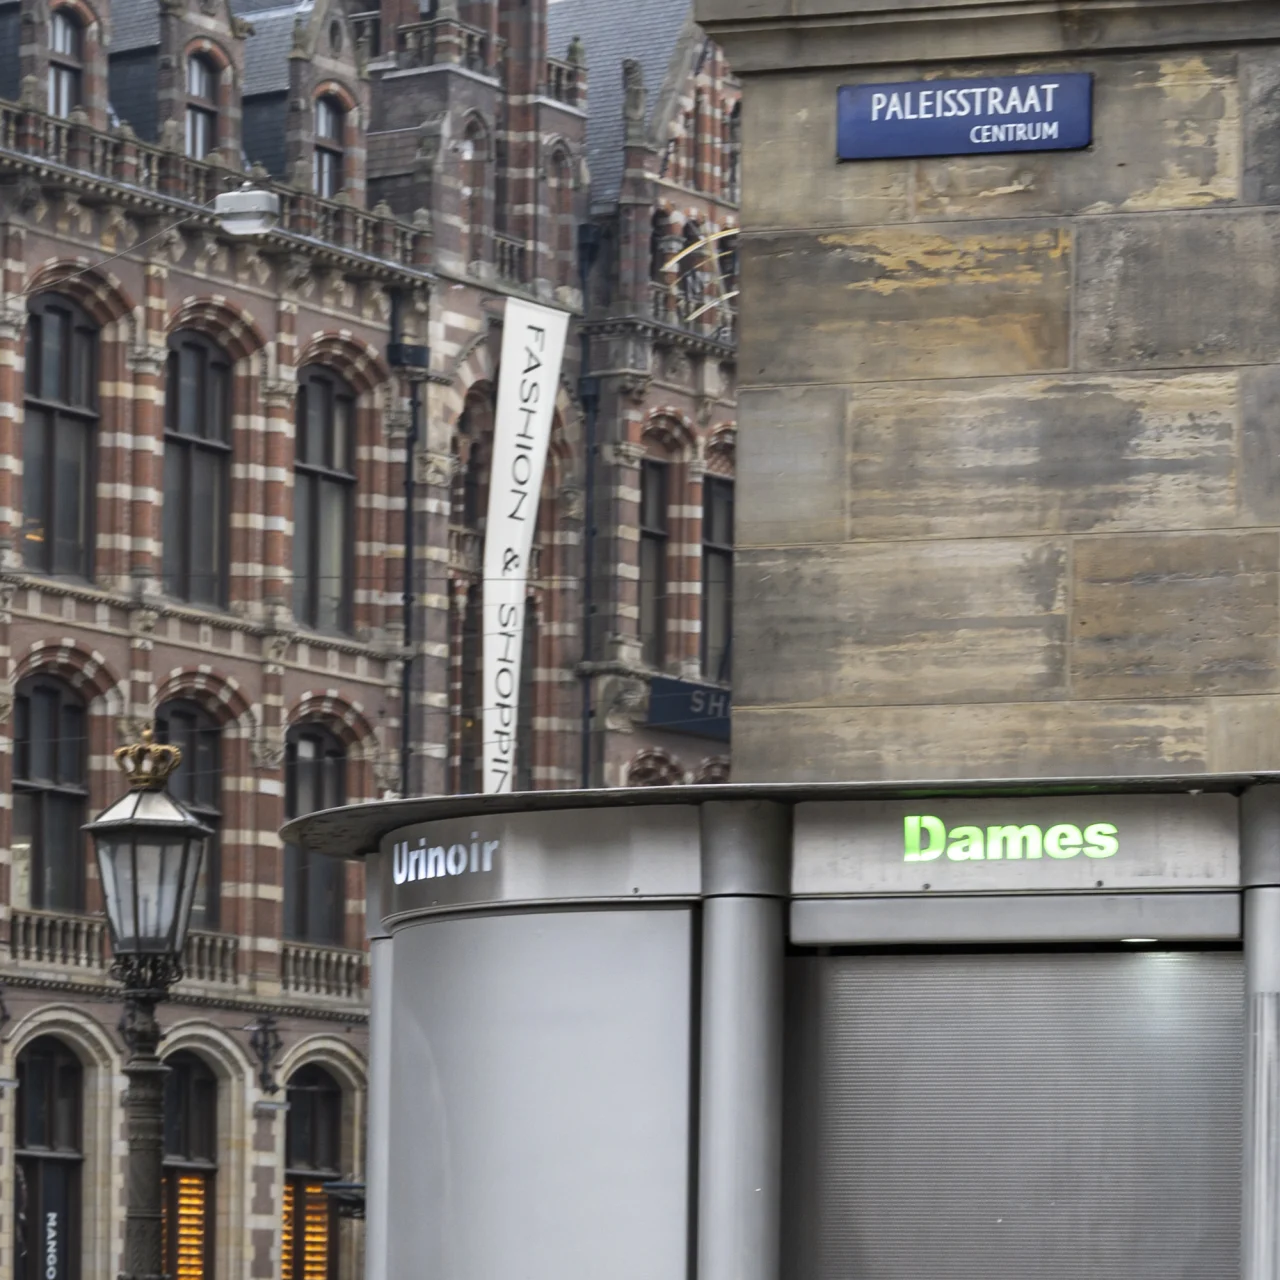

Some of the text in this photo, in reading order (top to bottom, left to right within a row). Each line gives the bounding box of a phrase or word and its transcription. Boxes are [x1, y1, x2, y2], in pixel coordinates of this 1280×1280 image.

[871, 84, 1059, 121] PALEISSTRAAT
[970, 121, 1059, 143] CENTRUM
[506, 324, 545, 521] FASHION
[501, 547, 519, 577] &
[689, 690, 731, 718] SH
[393, 831, 499, 885] Urinoir
[904, 815, 1119, 862] Dames
[46, 1212, 58, 1280] MANGO
